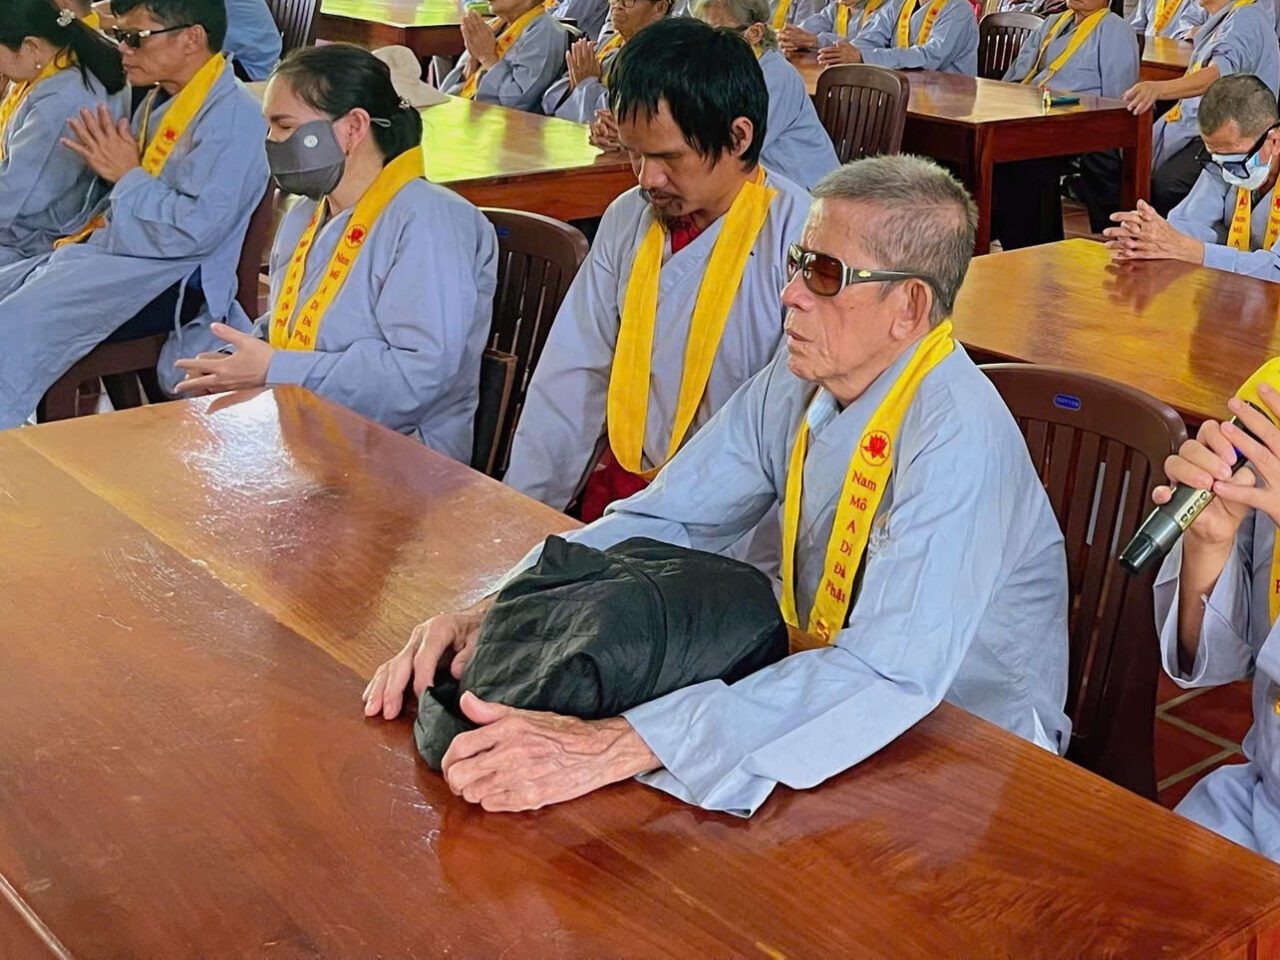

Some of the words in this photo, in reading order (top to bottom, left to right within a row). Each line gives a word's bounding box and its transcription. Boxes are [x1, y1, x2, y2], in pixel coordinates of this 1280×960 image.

[851, 470, 877, 492] Nam
[849, 495, 868, 512] Mô
[846, 520, 856, 535] A
[839, 541, 852, 557] Di
[833, 561, 846, 579] Đà
[825, 579, 846, 603] Phật
